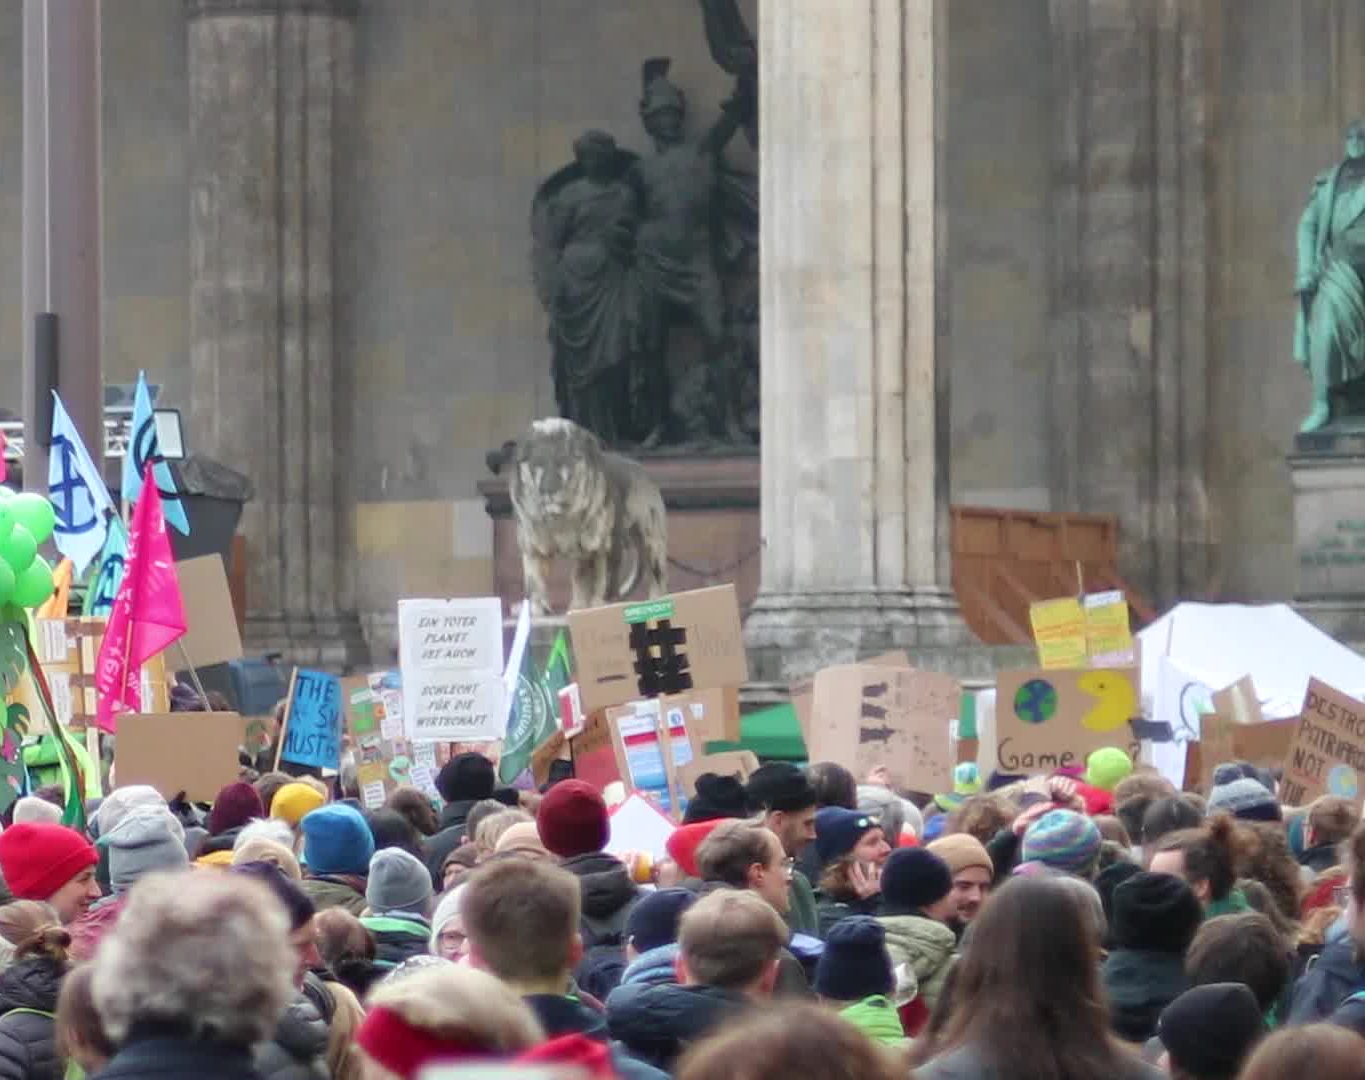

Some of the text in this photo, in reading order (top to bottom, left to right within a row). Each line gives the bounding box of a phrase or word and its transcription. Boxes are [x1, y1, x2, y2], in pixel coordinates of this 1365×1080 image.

[424, 631, 469, 643] PLANET
[297, 674, 335, 703] THE
[420, 683, 480, 696] SCHLECHT
[416, 713, 488, 728] WIRTSCHAFT
[997, 737, 1074, 771] Game
[1292, 745, 1326, 777] NOT
